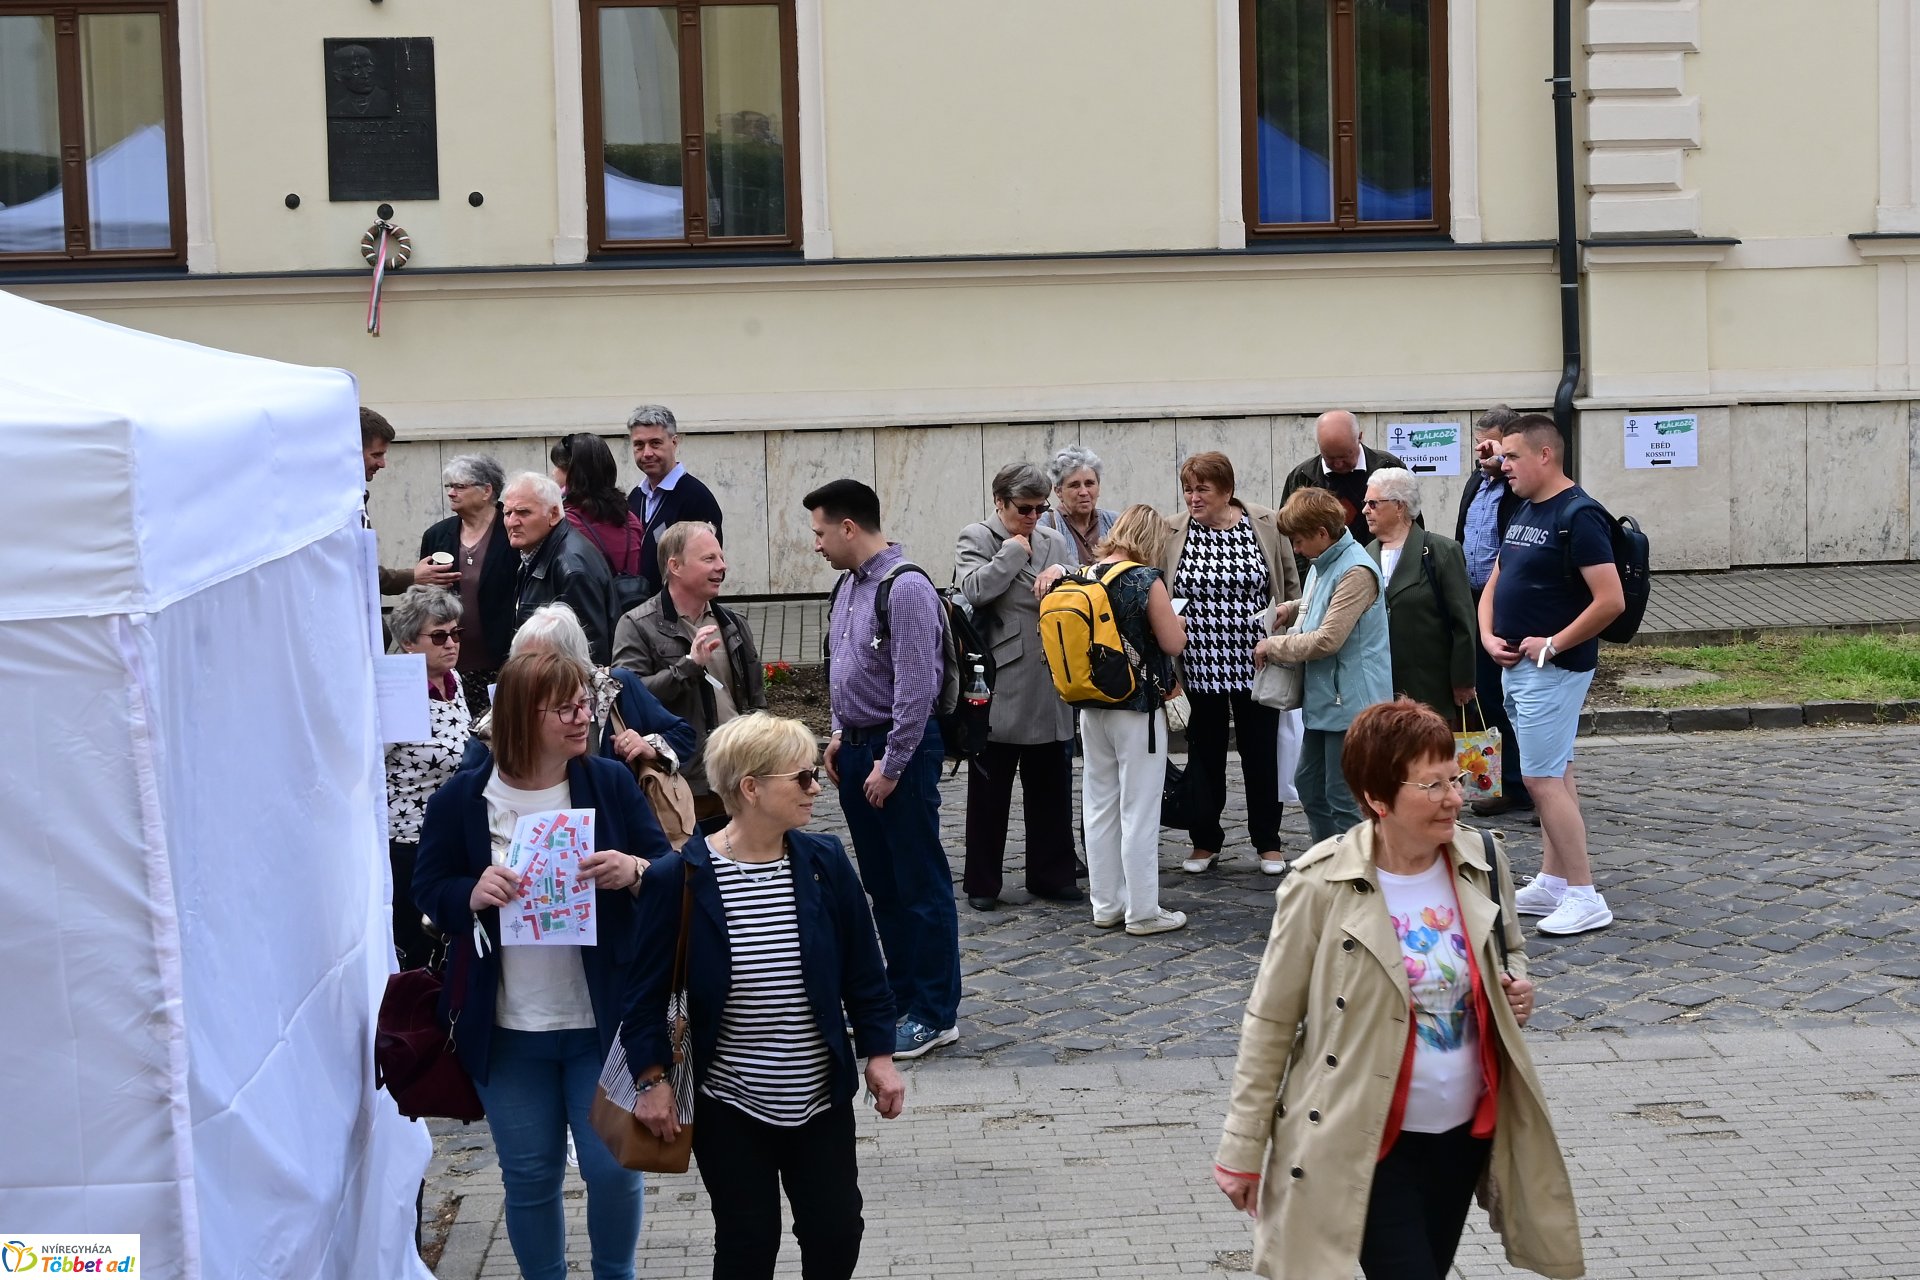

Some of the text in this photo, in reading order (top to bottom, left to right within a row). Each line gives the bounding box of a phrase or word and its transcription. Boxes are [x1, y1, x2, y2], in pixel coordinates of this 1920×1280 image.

[1650, 441, 1671, 449] EBÉD
[1429, 455, 1448, 463] pont
[1521, 526, 1549, 545] TOOLS
